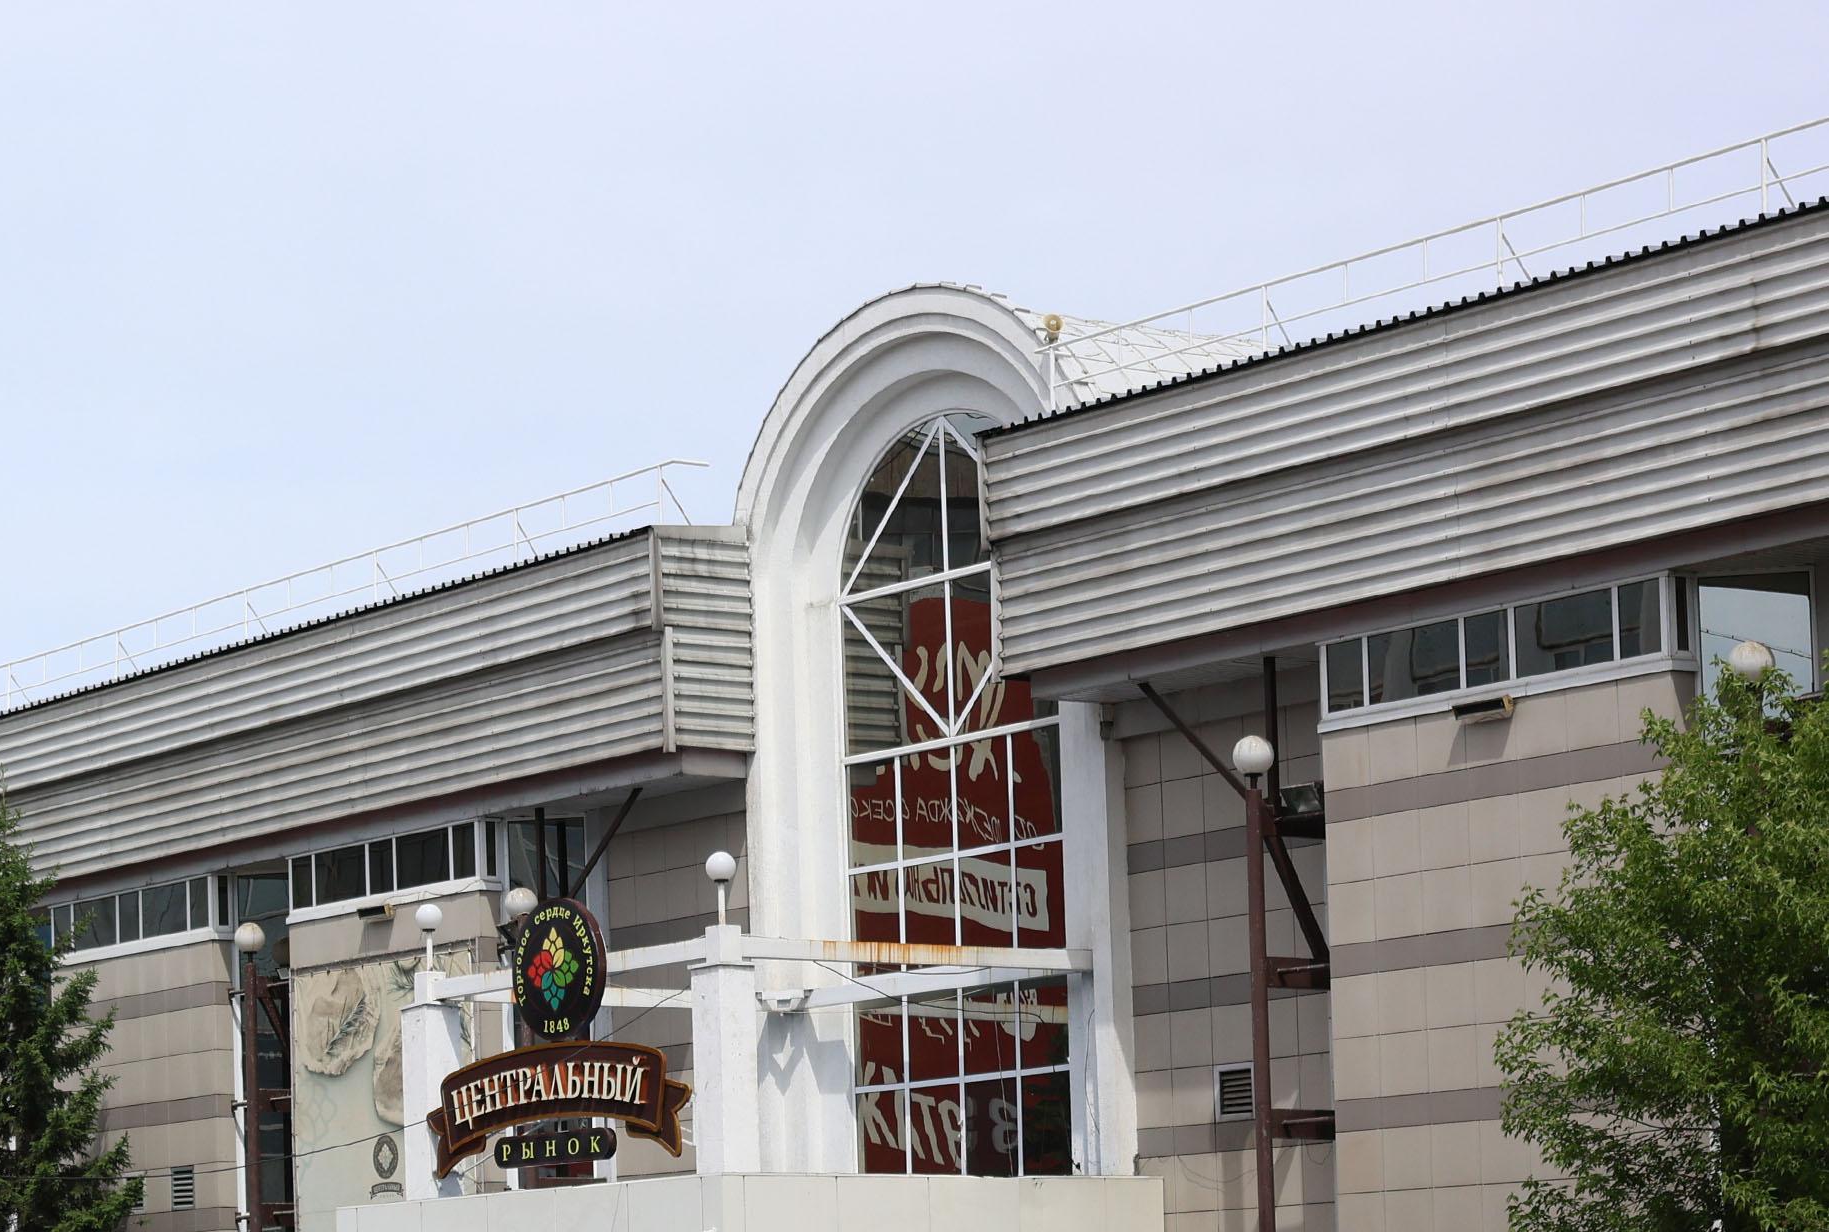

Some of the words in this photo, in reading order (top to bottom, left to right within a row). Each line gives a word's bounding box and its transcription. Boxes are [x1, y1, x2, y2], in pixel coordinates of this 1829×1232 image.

[534, 906, 571, 925] сердце
[572, 914, 594, 996] Иркутска
[543, 1017, 570, 1034] 1848
[451, 1056, 646, 1130] ЦЕНТРАЛЬНЫЙ
[501, 1135, 602, 1162] РЫНОК
